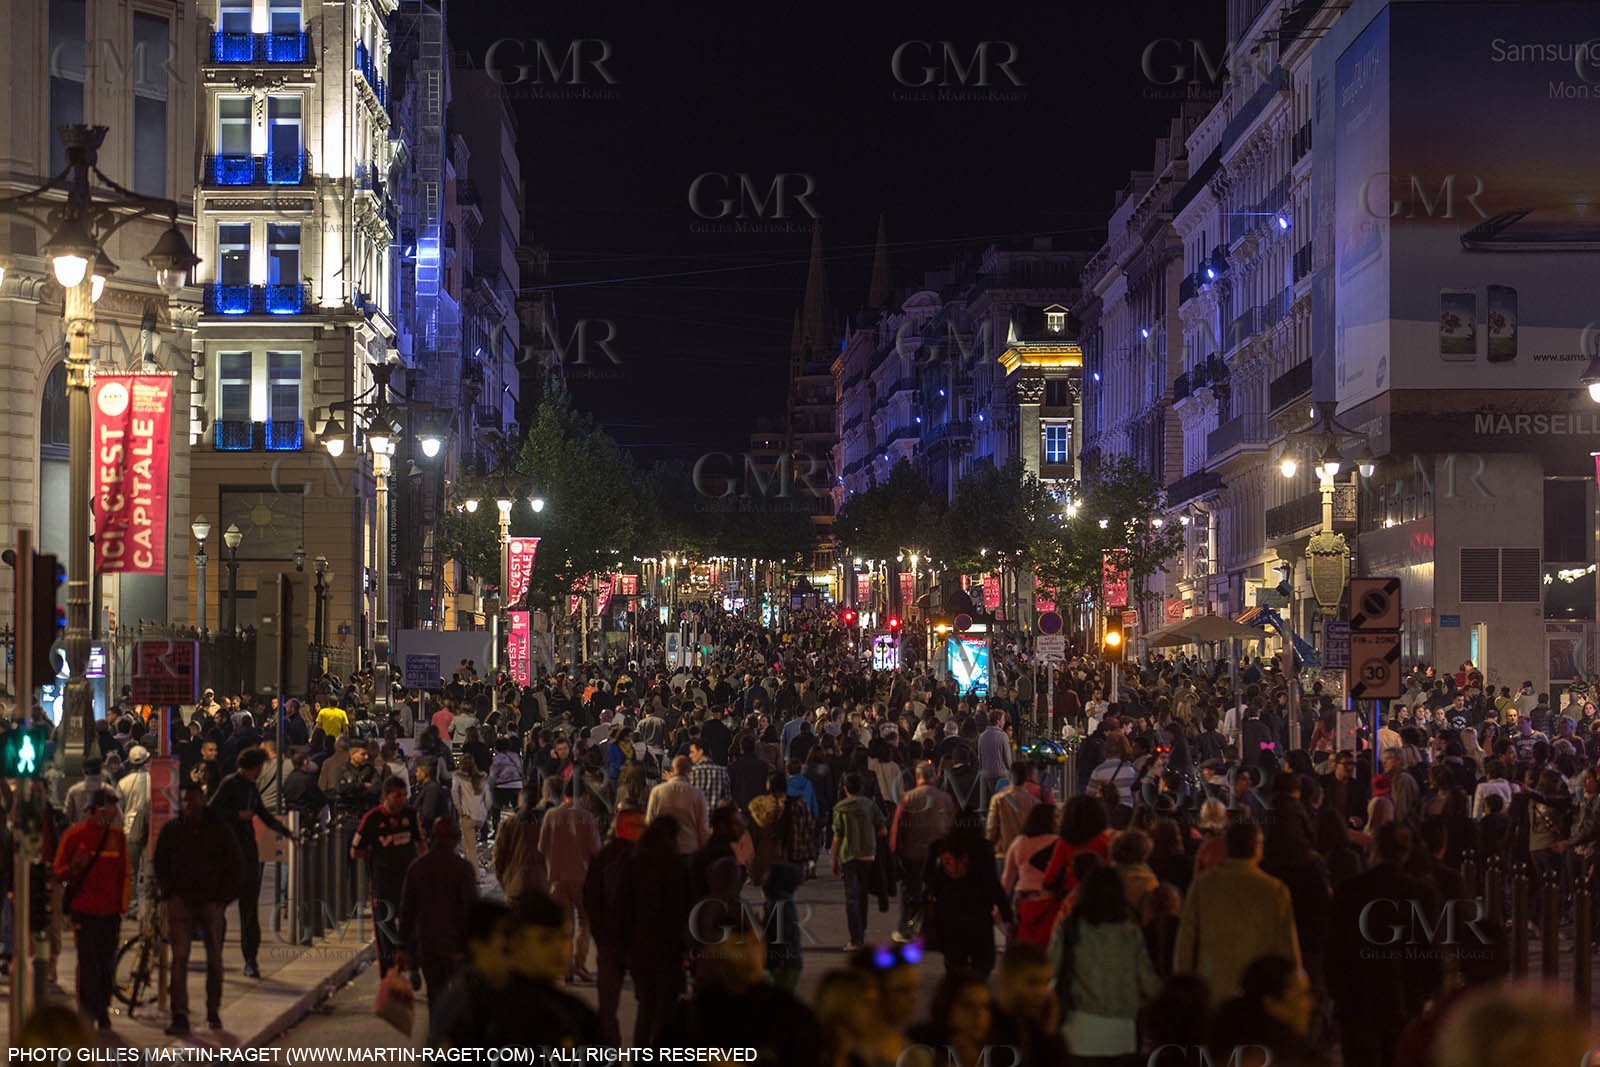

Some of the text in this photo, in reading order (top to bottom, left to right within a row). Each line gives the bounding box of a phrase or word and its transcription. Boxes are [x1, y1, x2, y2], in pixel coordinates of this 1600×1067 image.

[1549, 81, 1588, 99] Mon
[101, 424, 125, 511] C'EST
[132, 418, 154, 568] CAPITALE
[1367, 665, 1385, 681] 30
